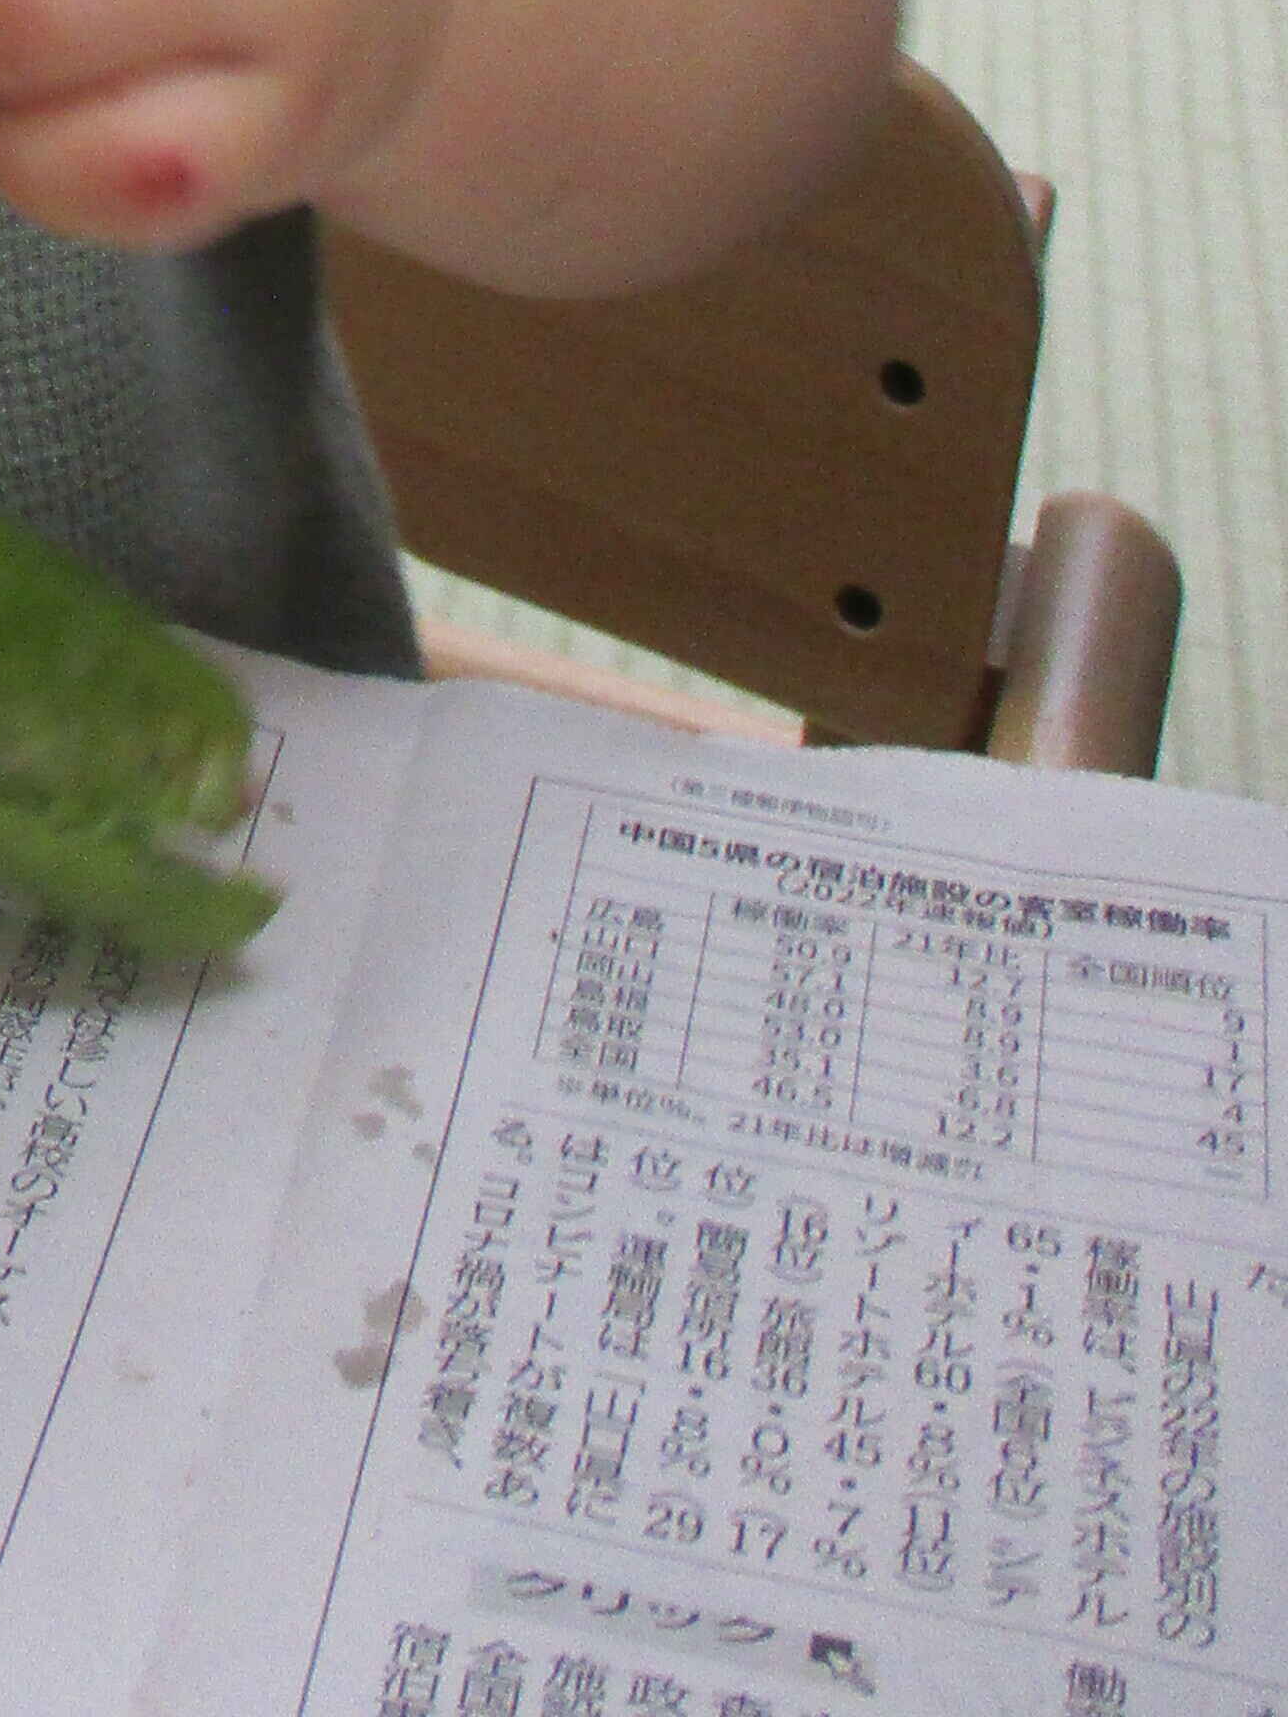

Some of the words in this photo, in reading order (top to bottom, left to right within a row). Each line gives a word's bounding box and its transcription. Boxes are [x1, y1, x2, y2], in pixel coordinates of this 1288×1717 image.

[583, 926, 659, 959] 山口
[506, 1571, 775, 1643] クリック
